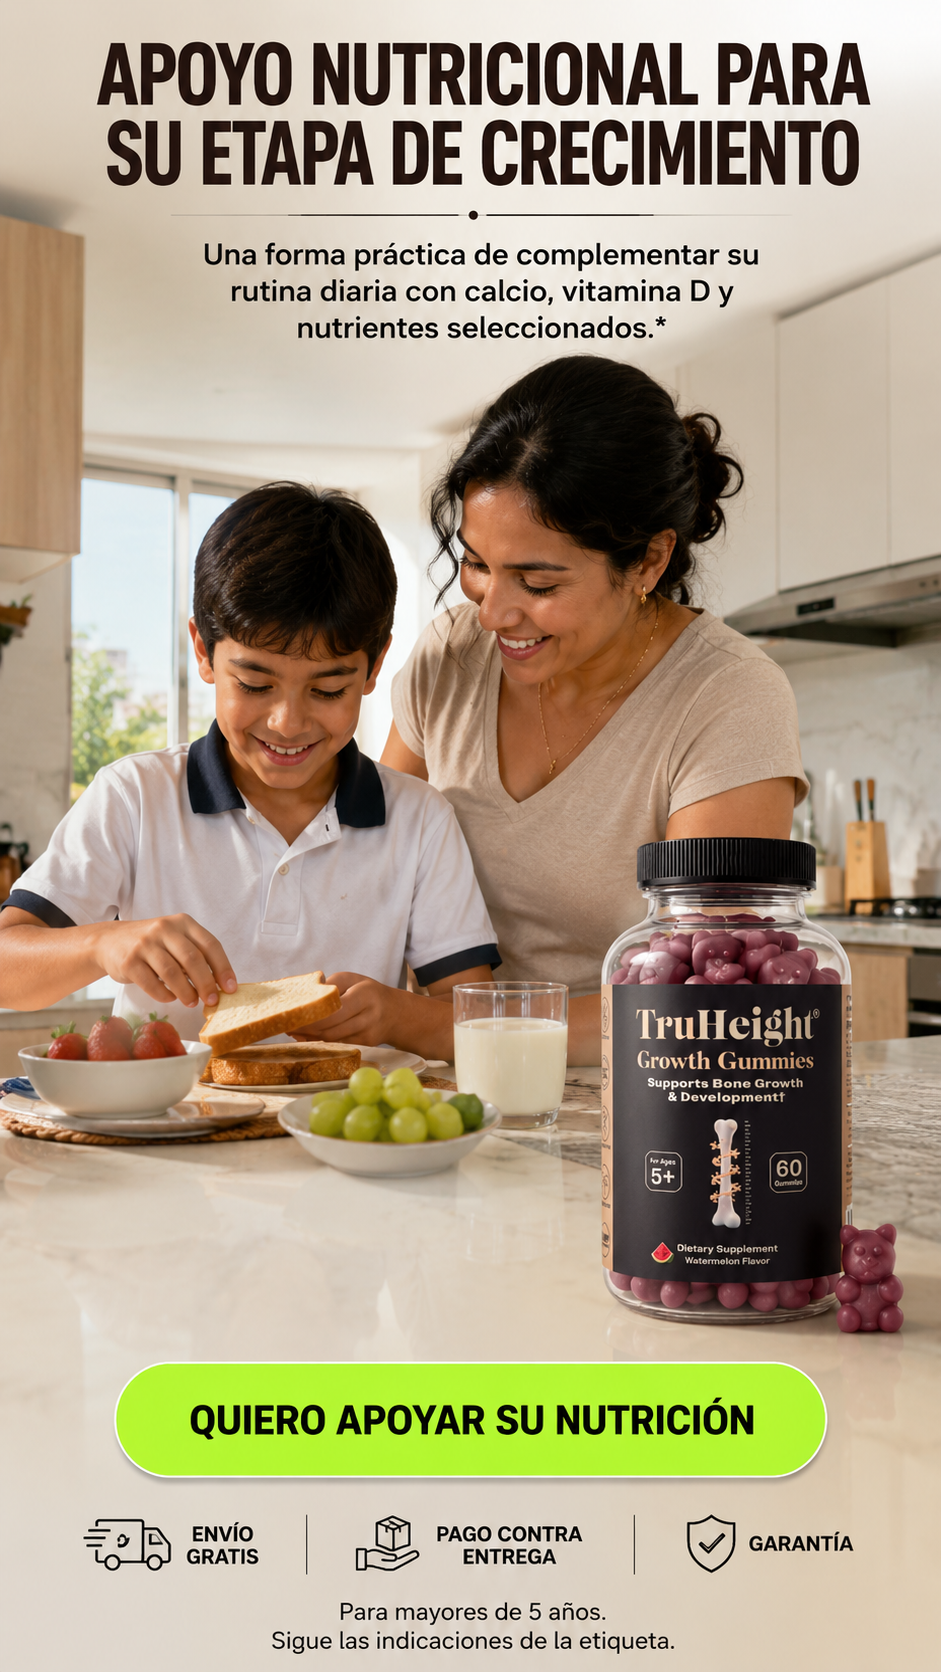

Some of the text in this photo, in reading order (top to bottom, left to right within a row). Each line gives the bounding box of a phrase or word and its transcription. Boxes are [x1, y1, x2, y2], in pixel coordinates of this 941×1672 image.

[637, 1050, 813, 1069] Growth Gummies
[648, 1077, 802, 1090] Supports Bone Growth
[668, 1092, 677, 1101] &
[777, 1160, 801, 1176] 60
[651, 1168, 674, 1185] 5+
[677, 1244, 777, 1254] Dietary Supplement
